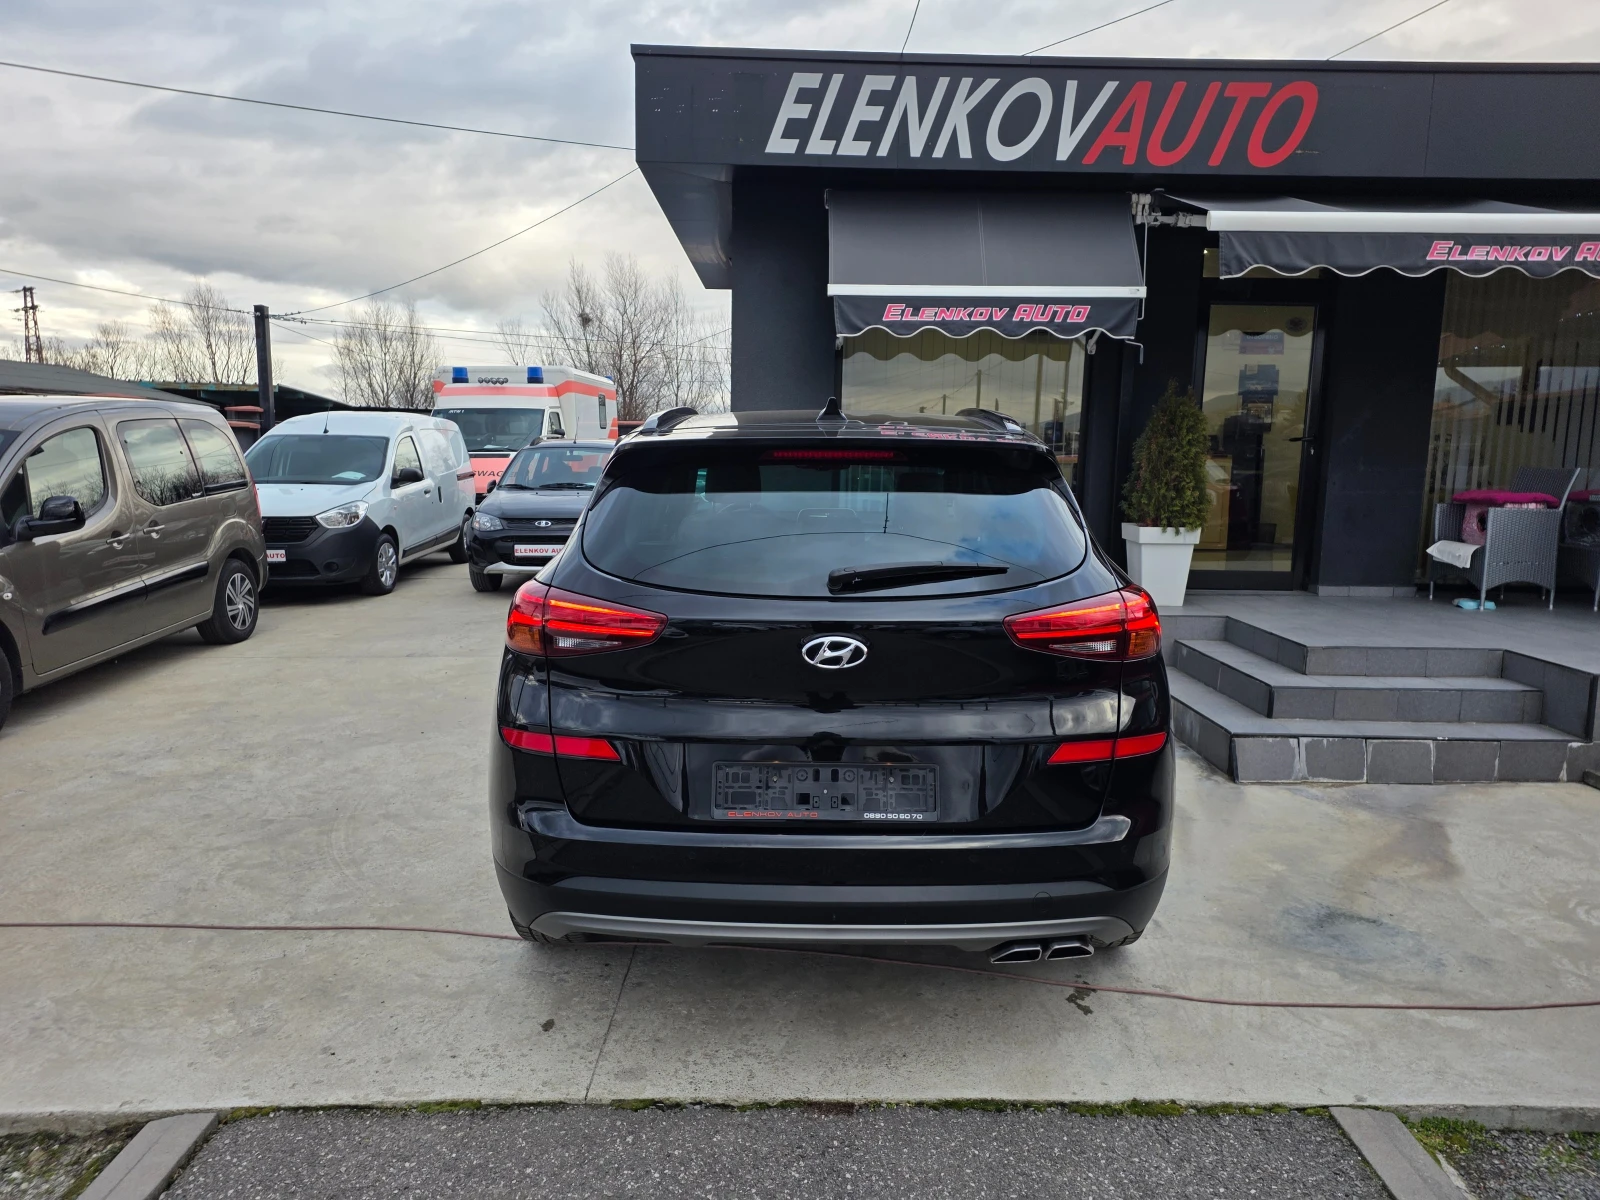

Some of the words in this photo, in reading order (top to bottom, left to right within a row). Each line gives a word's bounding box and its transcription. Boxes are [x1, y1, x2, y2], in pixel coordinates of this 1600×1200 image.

[1426, 240, 1572, 262] ELENKOV
[882, 303, 1009, 321] ELENKOV
[1012, 304, 1091, 322] AUTO
